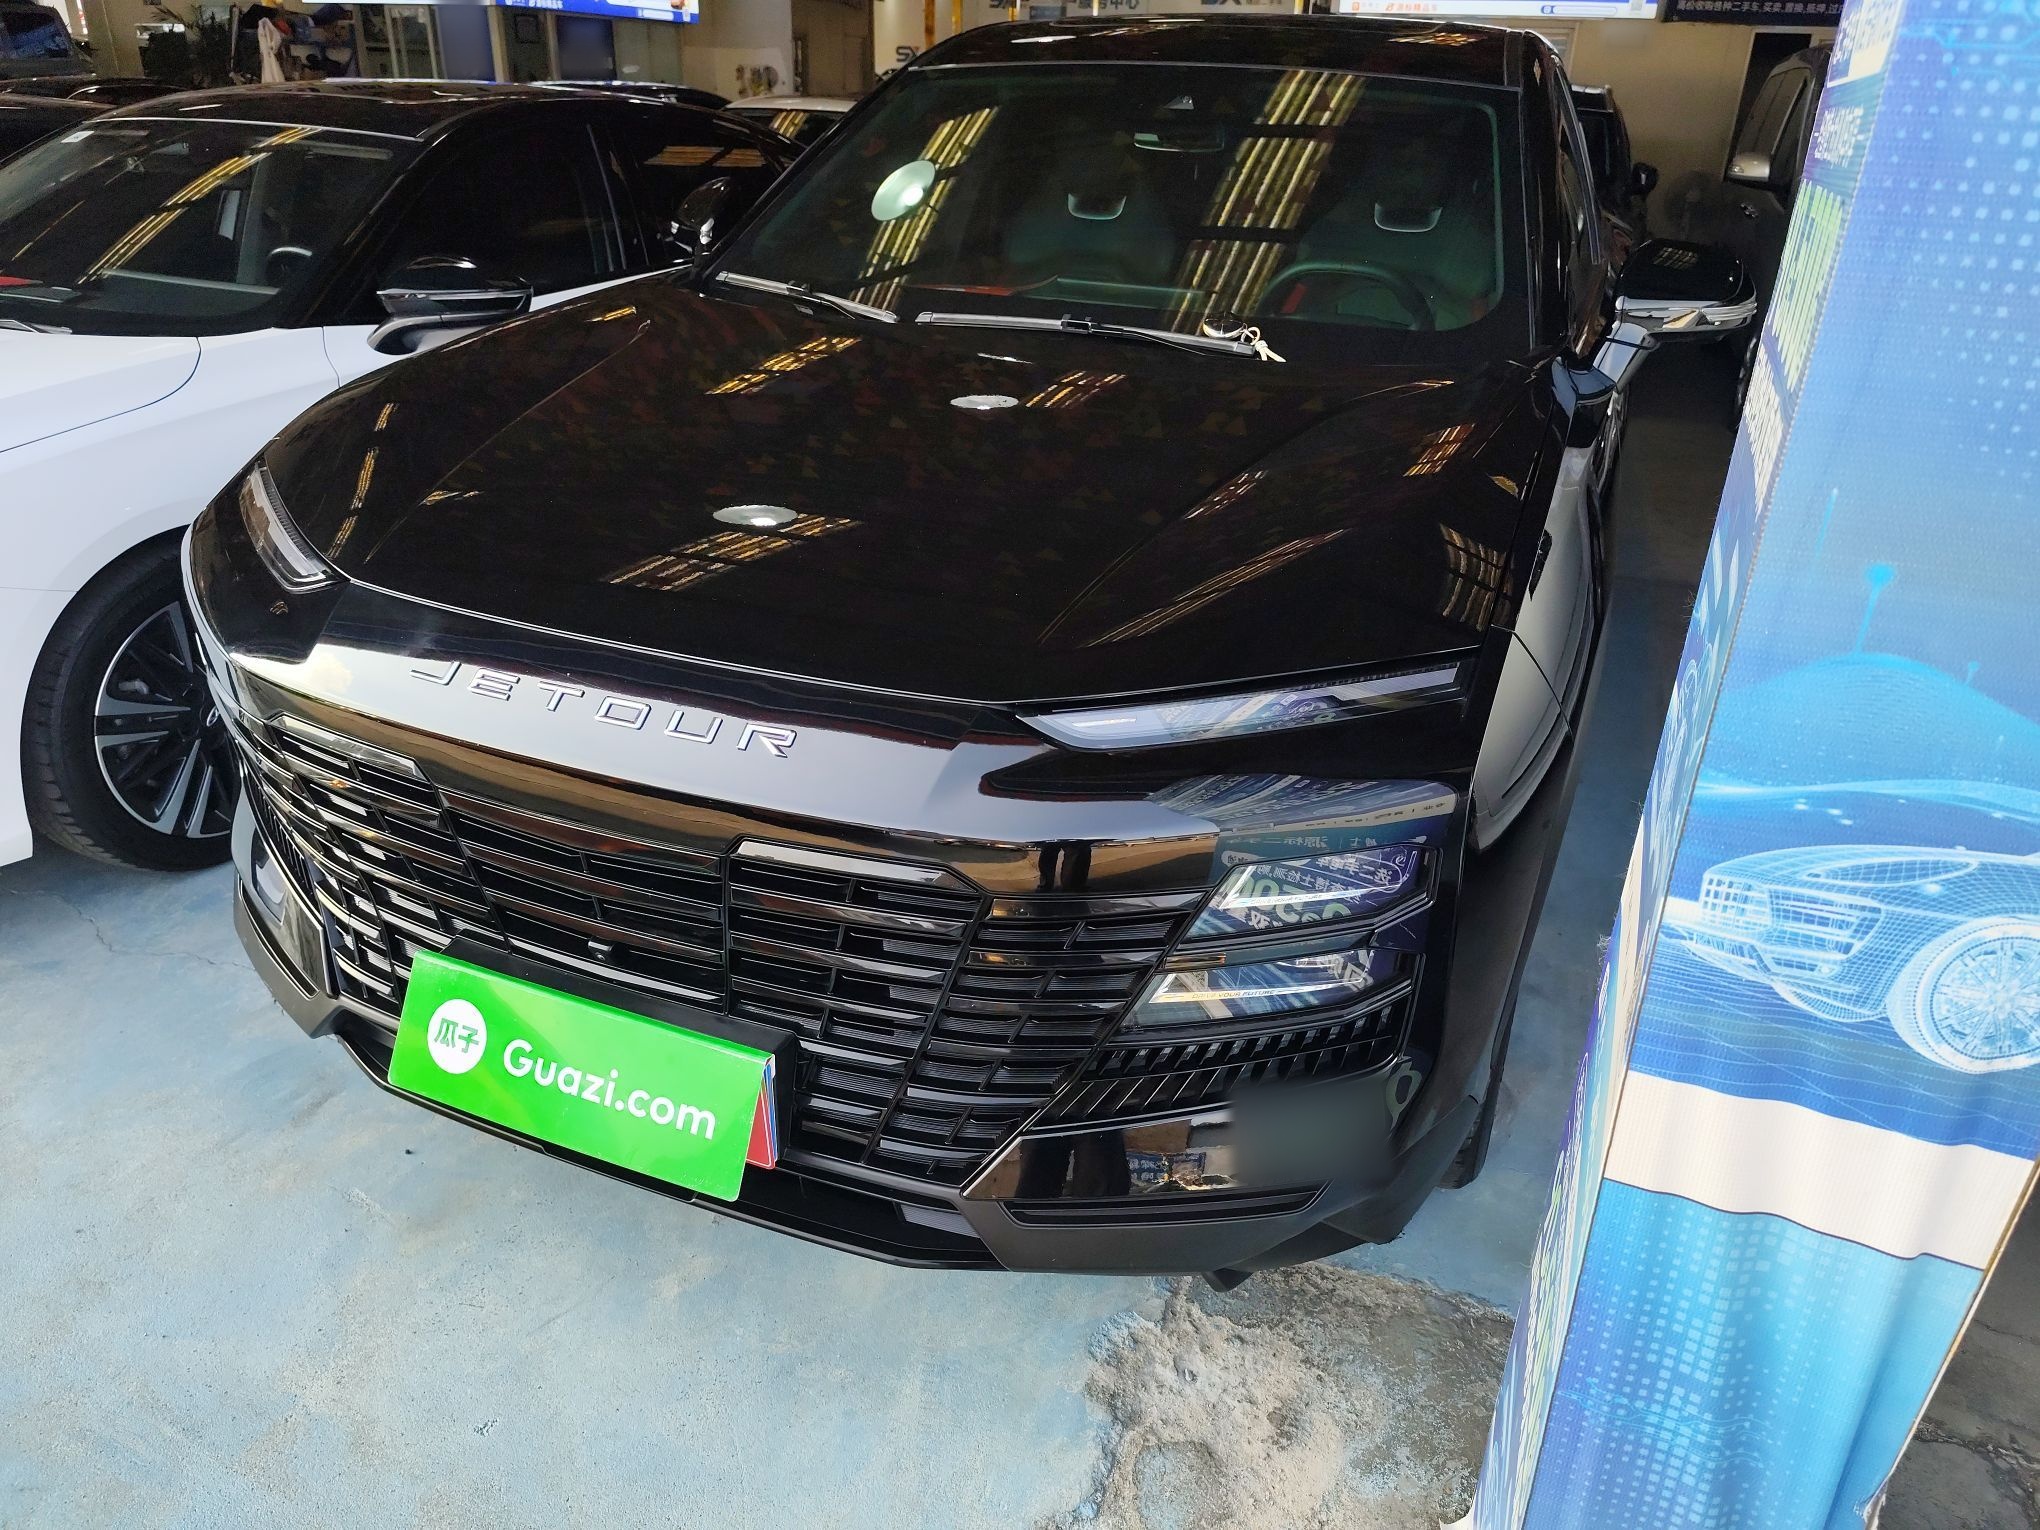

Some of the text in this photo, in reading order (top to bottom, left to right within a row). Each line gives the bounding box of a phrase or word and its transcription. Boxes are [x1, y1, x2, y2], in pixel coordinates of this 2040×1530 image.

[410, 660, 798, 758] JETOUR
[433, 1017, 480, 1054] 瓜子
[503, 1038, 716, 1140] Guazi.com
